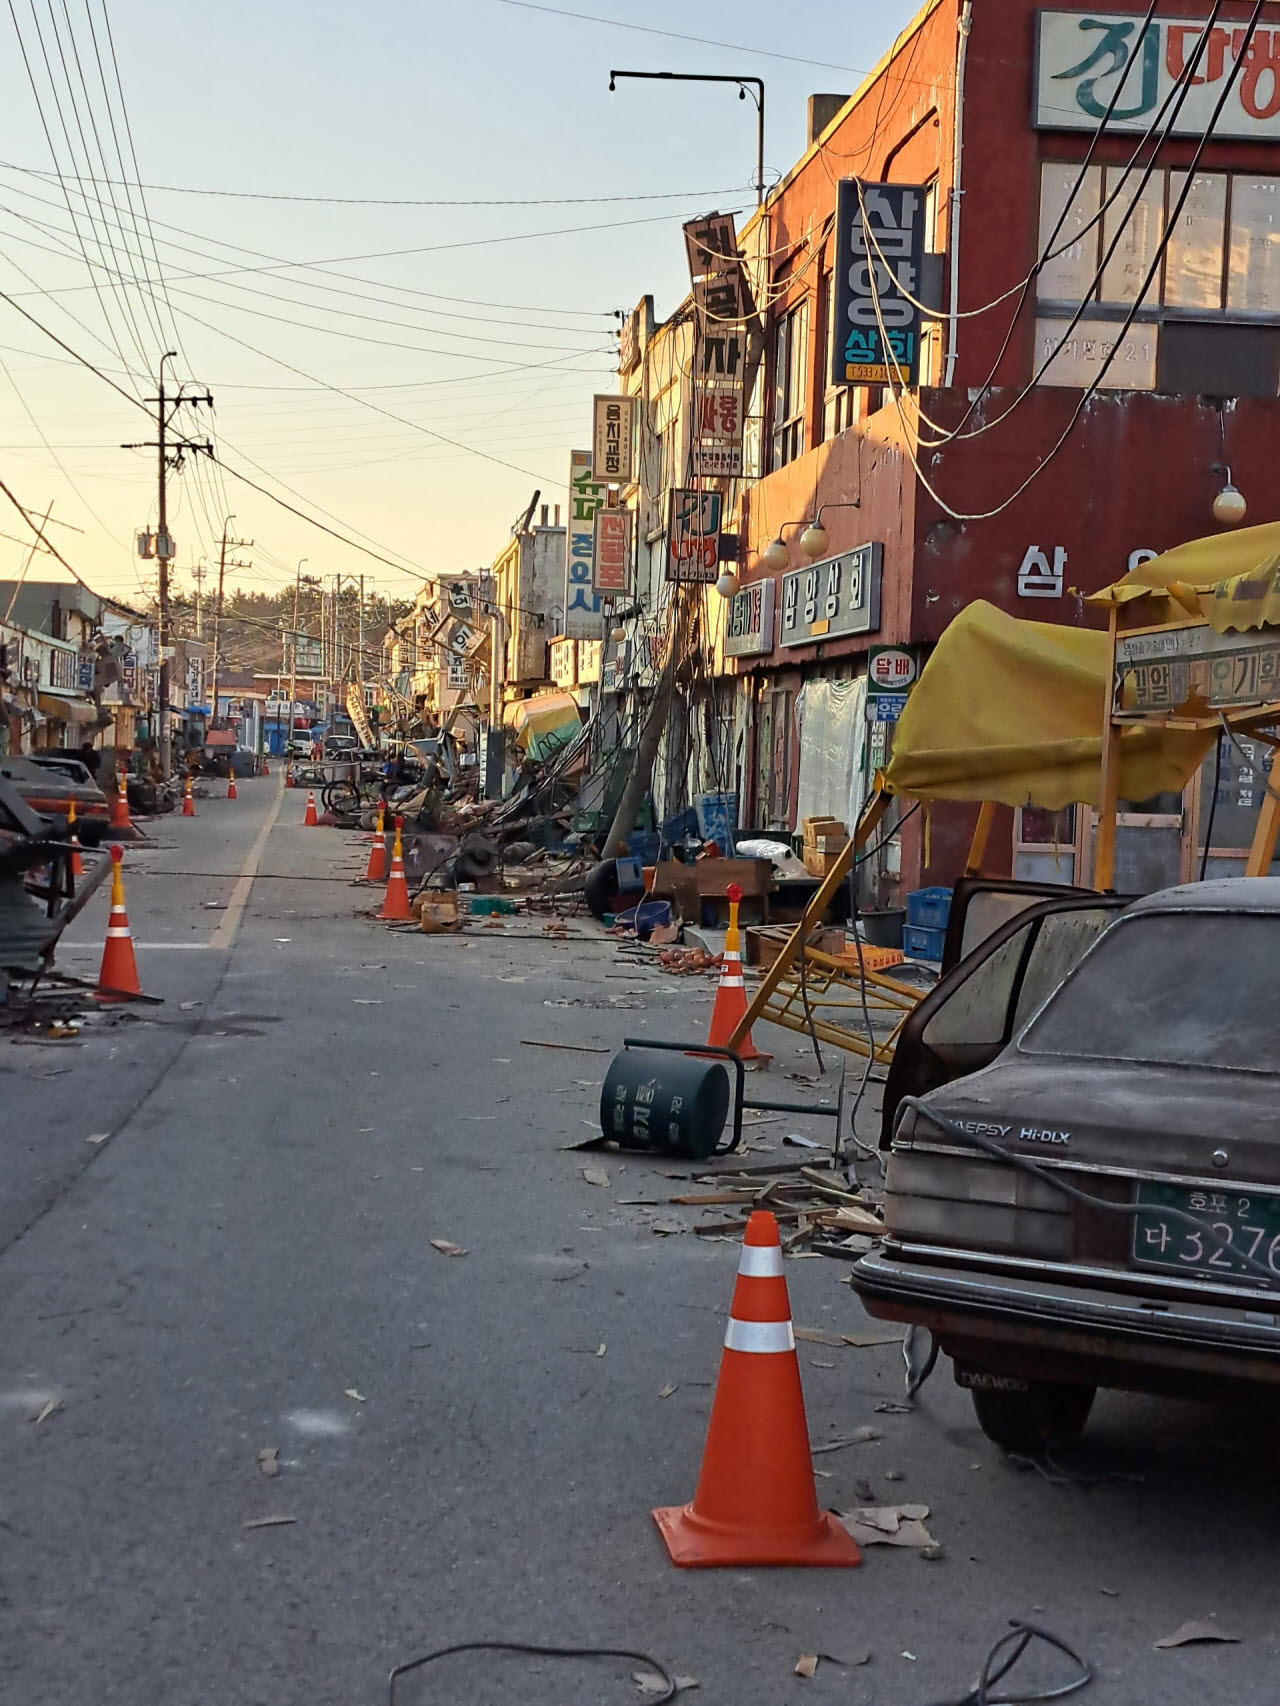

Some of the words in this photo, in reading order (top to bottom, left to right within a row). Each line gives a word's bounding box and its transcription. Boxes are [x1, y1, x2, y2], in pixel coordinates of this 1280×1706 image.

[848, 188, 919, 327] 삼양
[844, 329, 914, 364] 상회
[785, 552, 864, 629] 삼양상회
[876, 658, 910, 675] 담배
[1237, 1198, 1250, 1218] 2
